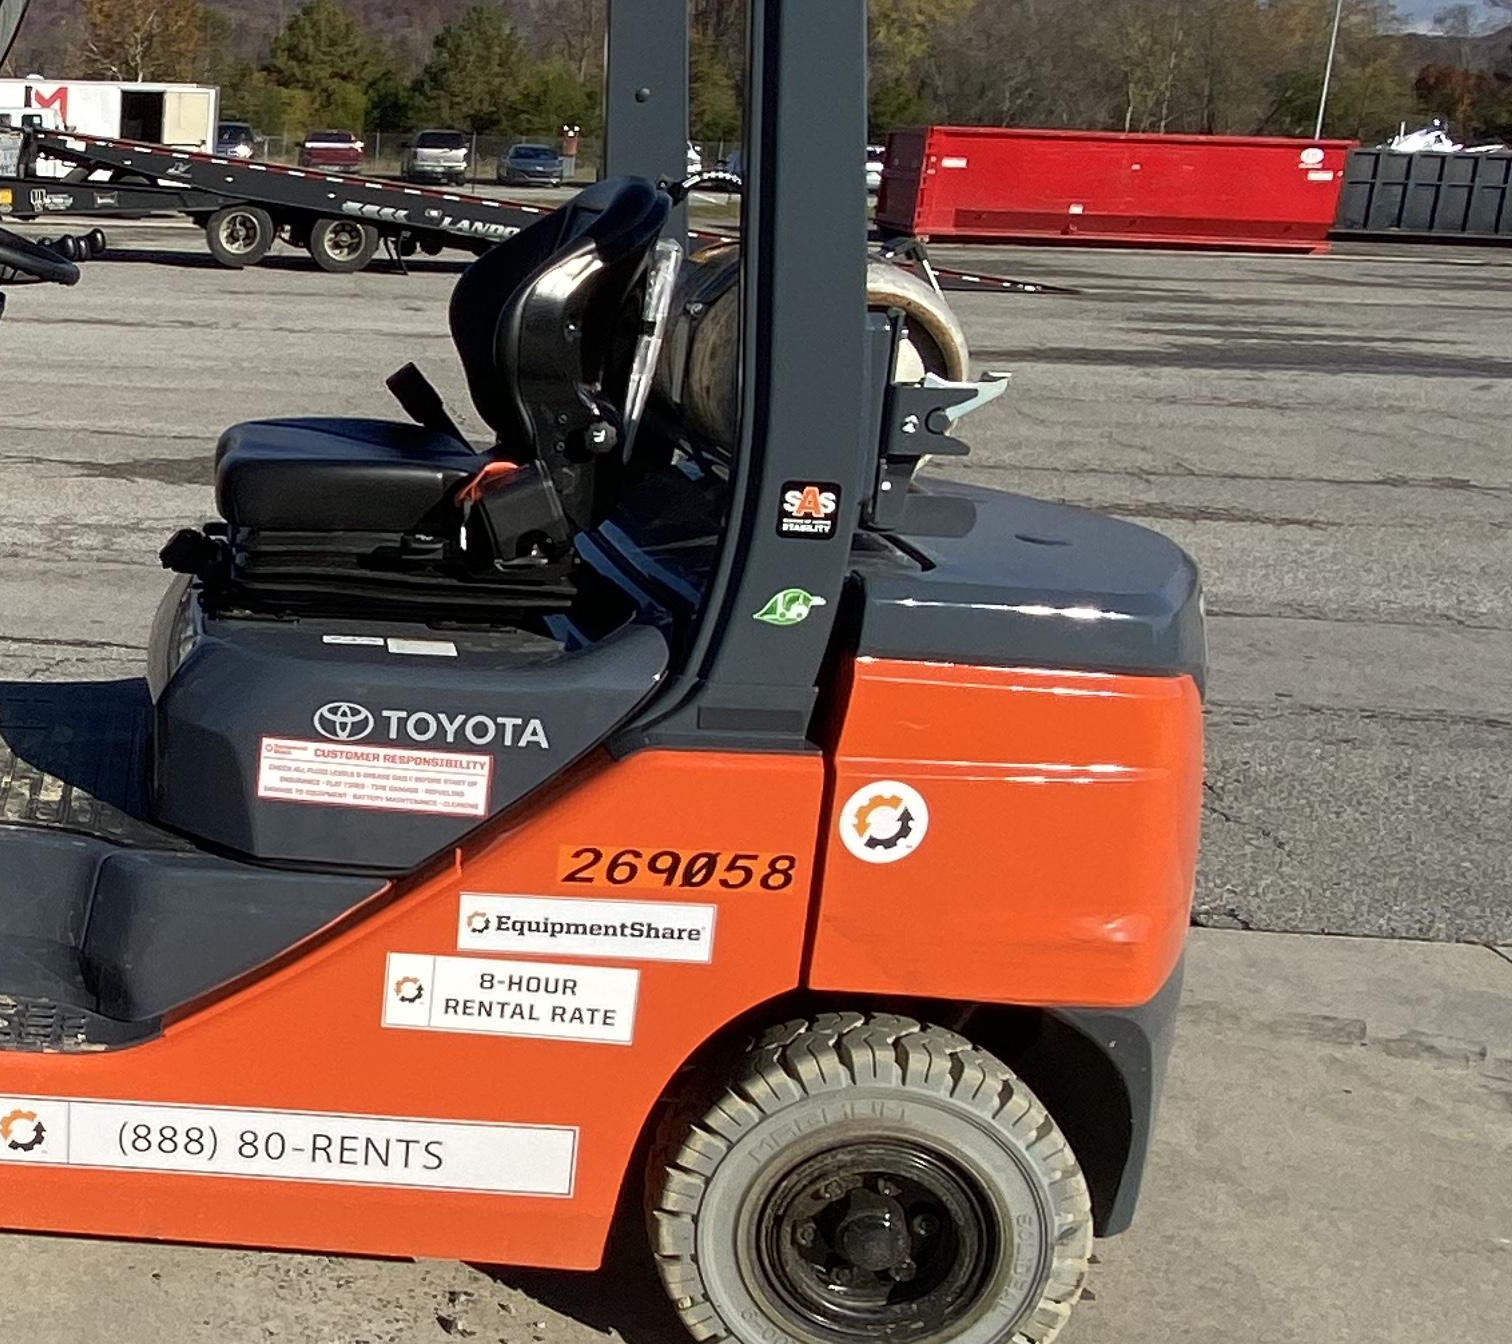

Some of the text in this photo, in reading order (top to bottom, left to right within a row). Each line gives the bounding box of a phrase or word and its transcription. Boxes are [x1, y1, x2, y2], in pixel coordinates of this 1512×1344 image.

[782, 486, 836, 518] SAS
[381, 709, 550, 750] TOYOTA
[314, 747, 380, 763] CUSTOMER
[383, 753, 486, 771] RESPONSIBILITY
[494, 914, 702, 943] EquipmentShare
[479, 972, 578, 997] 8-HOUR
[444, 997, 617, 1027] RENTAL RATE
[117, 1120, 445, 1172] (888) 80-RENTS
